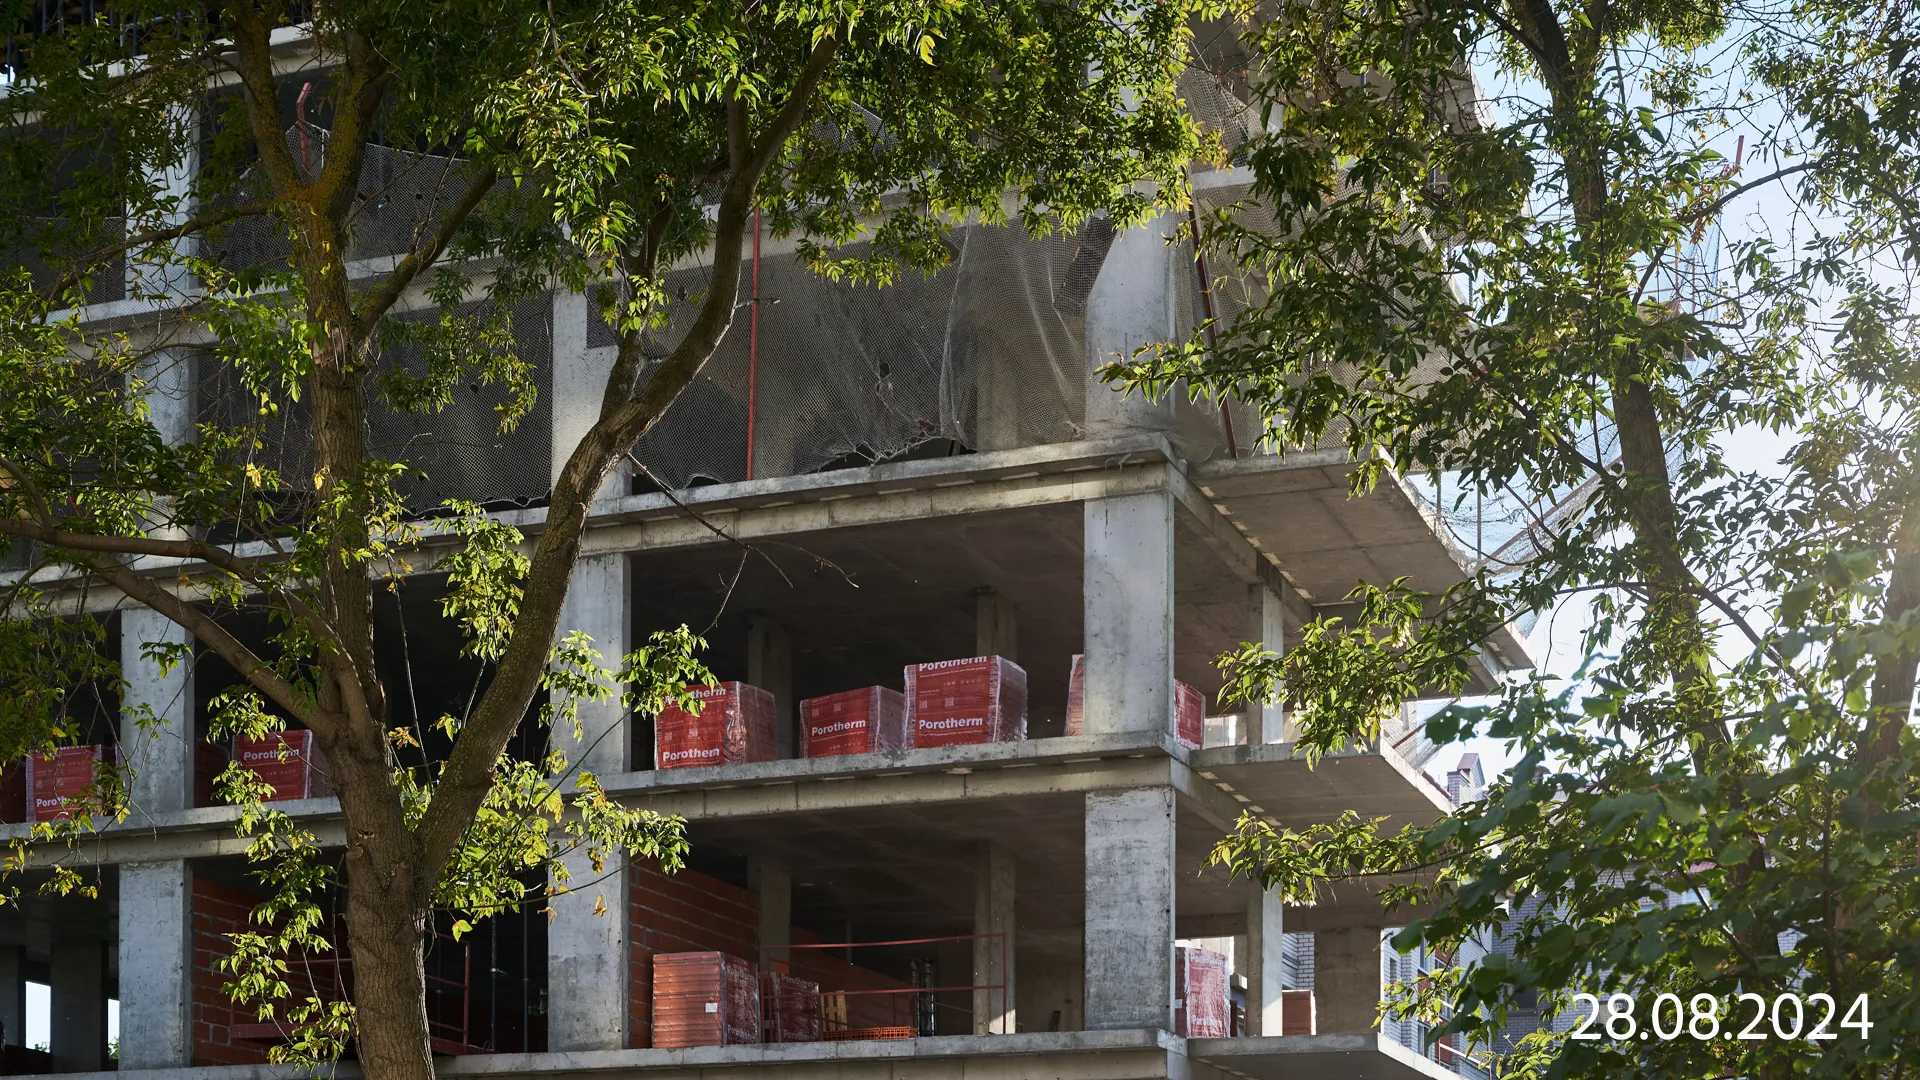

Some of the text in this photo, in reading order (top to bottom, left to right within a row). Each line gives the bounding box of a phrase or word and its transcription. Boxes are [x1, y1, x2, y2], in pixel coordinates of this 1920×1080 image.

[812, 719, 866, 737] Porotherm
[919, 717, 983, 730] Porotherm
[243, 749, 299, 760] Porothrm
[662, 748, 720, 761] Porothem
